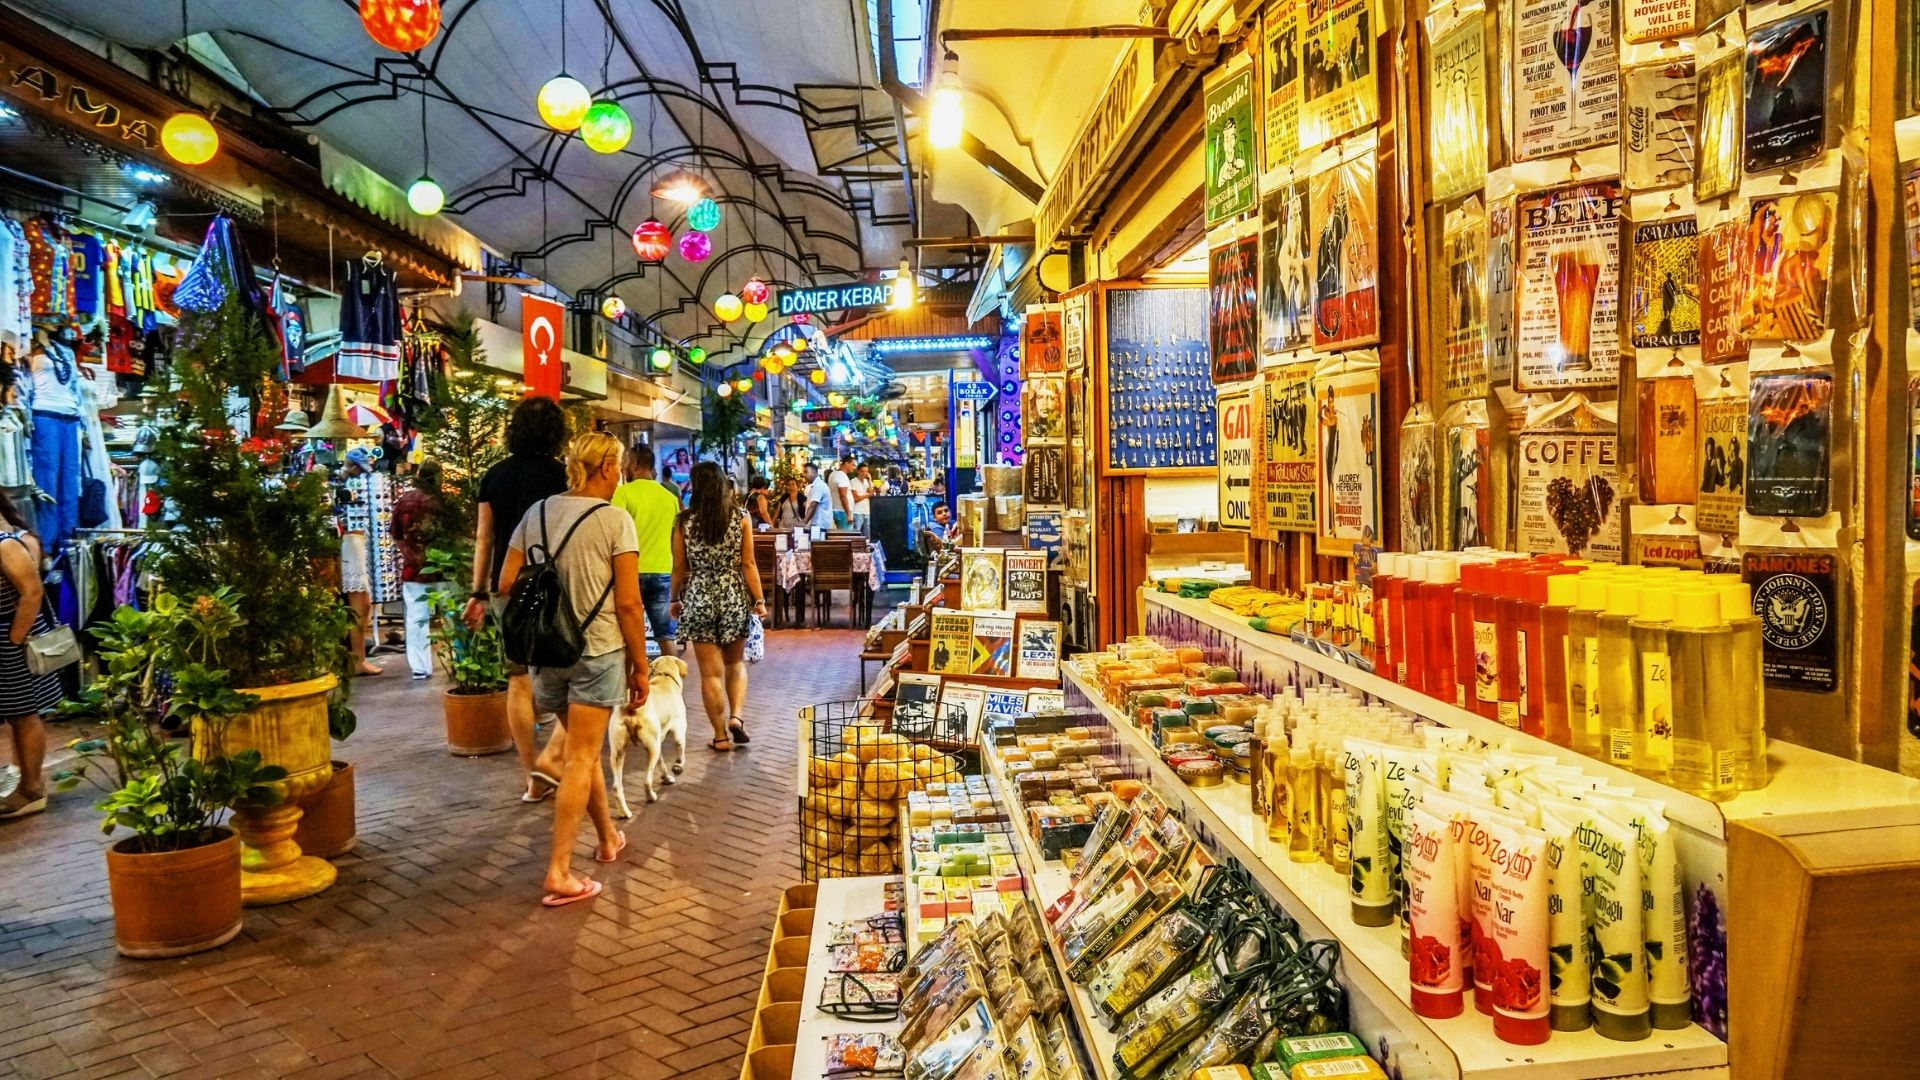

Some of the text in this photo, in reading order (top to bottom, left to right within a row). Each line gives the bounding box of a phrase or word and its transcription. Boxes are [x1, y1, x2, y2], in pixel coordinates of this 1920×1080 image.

[1521, 4, 1550, 20] SAUVIGNON
[1648, 10, 1690, 26] WILL BE
[1306, 19, 1330, 40] FIRST U.S
[1521, 42, 1548, 57] MERLOT
[1582, 74, 1618, 90] ZINFANDEL
[1104, 49, 1138, 151] SHOP
[1208, 74, 1248, 126] Breasts!
[1534, 86, 1564, 100] RIESLING
[1579, 96, 1602, 108] CABERNET
[1530, 102, 1566, 119] PINOT NOIR
[1522, 126, 1554, 138] SANGIOVESE
[1572, 137, 1592, 149] FRIENDS
[1528, 228, 1566, 239] AROUND
[1570, 225, 1592, 234] THE
[782, 285, 893, 314] DÖNER KEBAP
[1636, 332, 1698, 348] PRAGUE
[1338, 474, 1360, 482] AUDREY
[1336, 482, 1362, 492] HEPBURN
[1226, 500, 1250, 520] ONL
[1644, 545, 1662, 558] Led
[1008, 558, 1044, 570] CONCERT
[1748, 556, 1830, 574] RAMONES
[1010, 572, 1042, 582] STONE
[1764, 577, 1811, 594] JOHNNY
[1010, 590, 1042, 600] PILOTS
[1809, 592, 1824, 622] JOEY
[1756, 594, 1774, 638] TOMY
[1022, 650, 1056, 659] LEON
[986, 694, 1024, 706] MILES
[985, 704, 1022, 714] DAVIS
[1490, 838, 1532, 880] Zeytin
[1120, 908, 1138, 926] Zeytin
[1494, 900, 1515, 924] Nar
[1070, 962, 1088, 980] Zeytin
